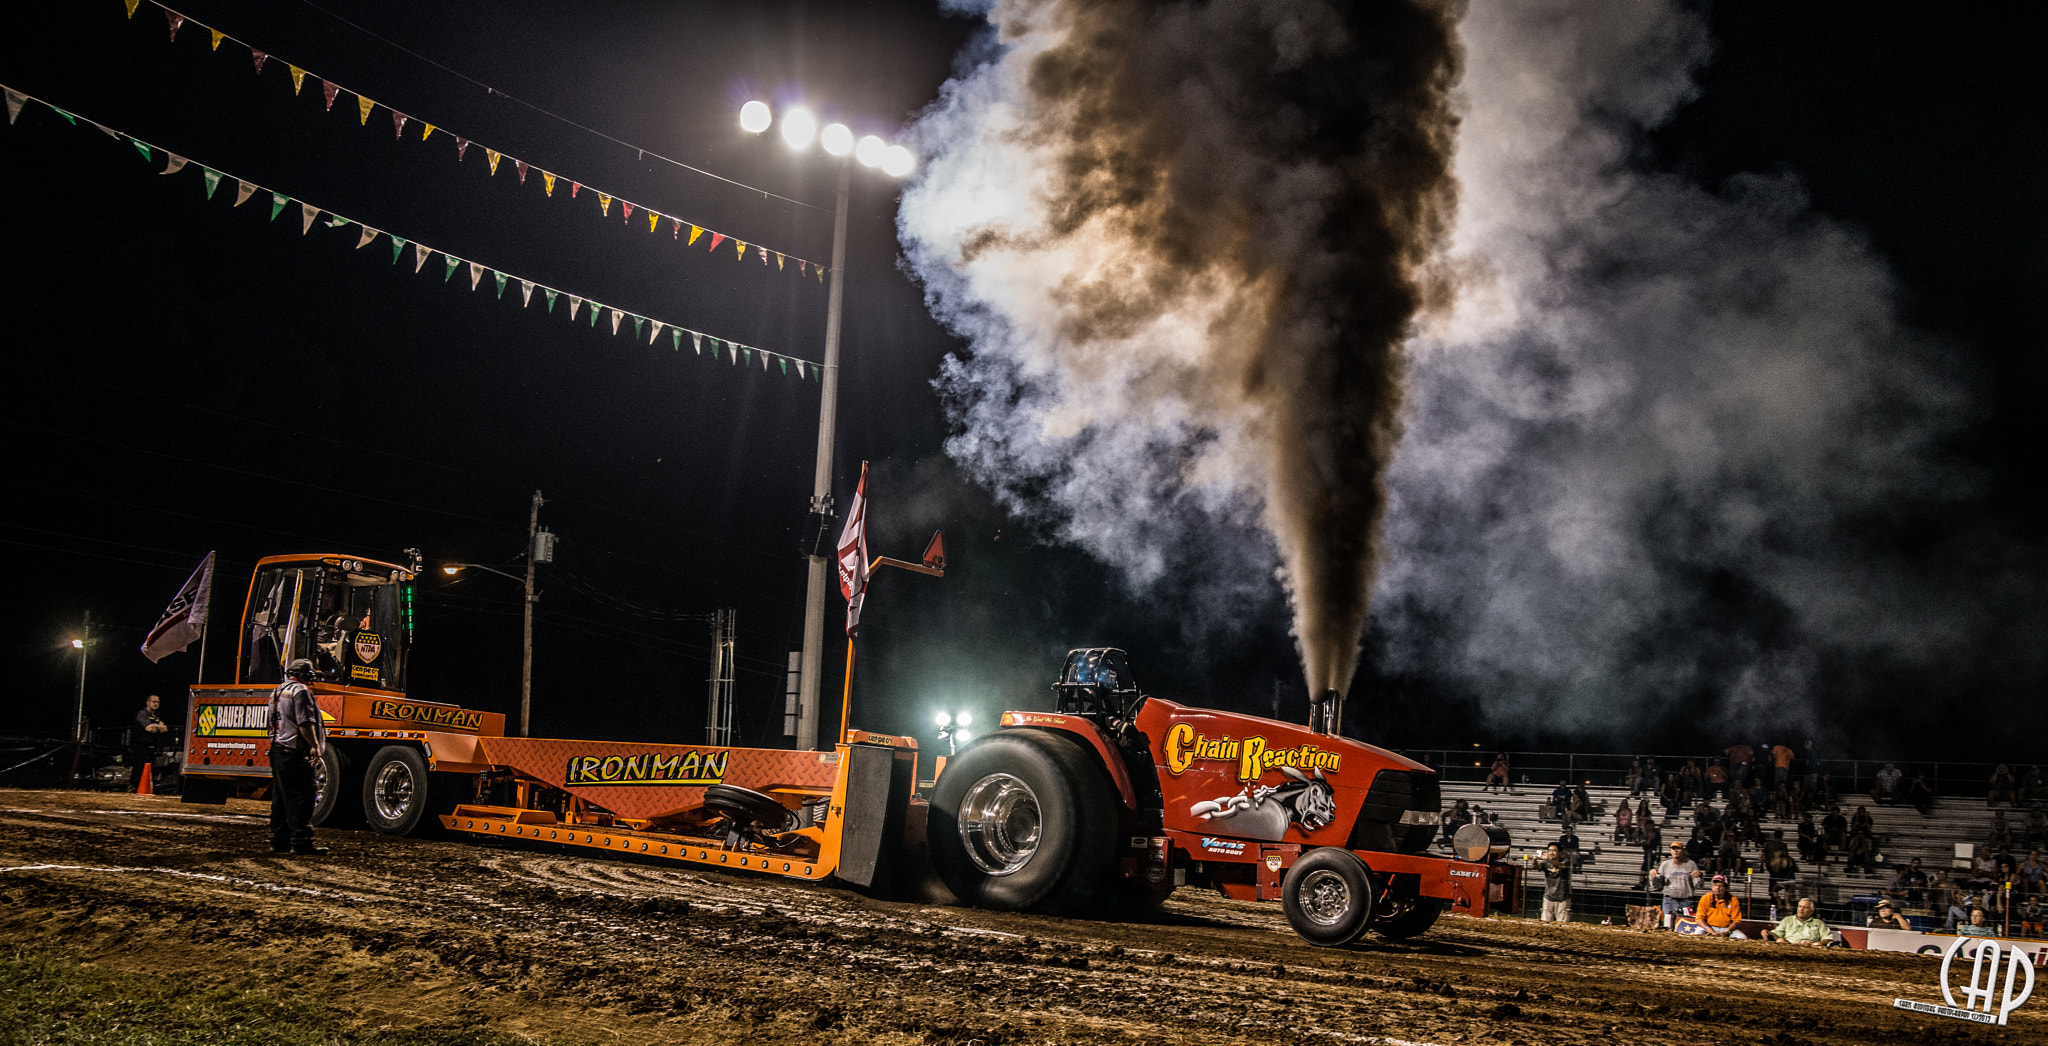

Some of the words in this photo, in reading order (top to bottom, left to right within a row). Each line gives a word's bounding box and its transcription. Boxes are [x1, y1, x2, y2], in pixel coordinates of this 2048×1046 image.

[217, 705, 245, 728] BAUER
[245, 705, 269, 728] BUILT
[371, 700, 484, 731] IRONMAN
[565, 750, 730, 783] IRONMAN
[1165, 722, 1240, 775] Chain
[1239, 735, 1342, 782] Reaction
